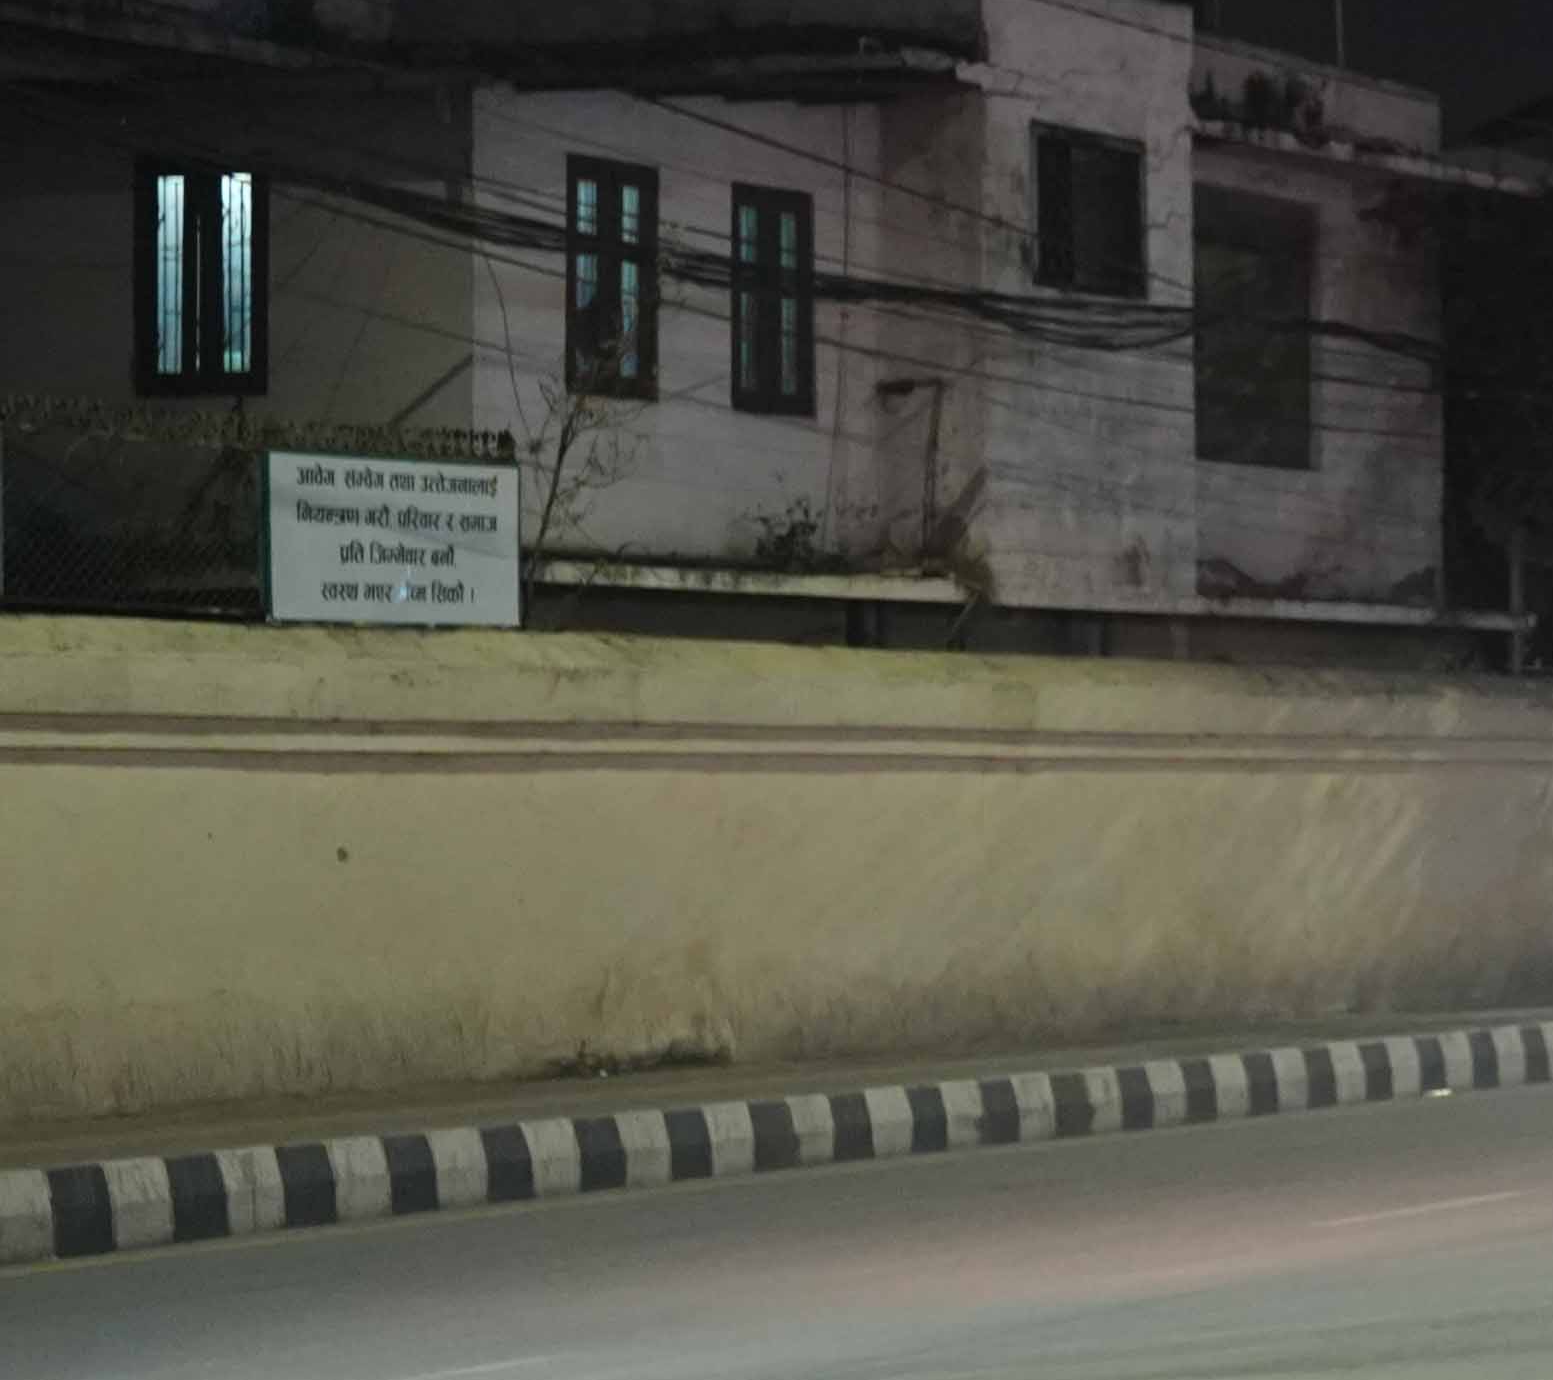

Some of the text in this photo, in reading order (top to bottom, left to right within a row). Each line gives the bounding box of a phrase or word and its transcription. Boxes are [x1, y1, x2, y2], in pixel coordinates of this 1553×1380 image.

[388, 474, 415, 492] तथा
[446, 513, 454, 531] र
[340, 540, 364, 565] प्रति
